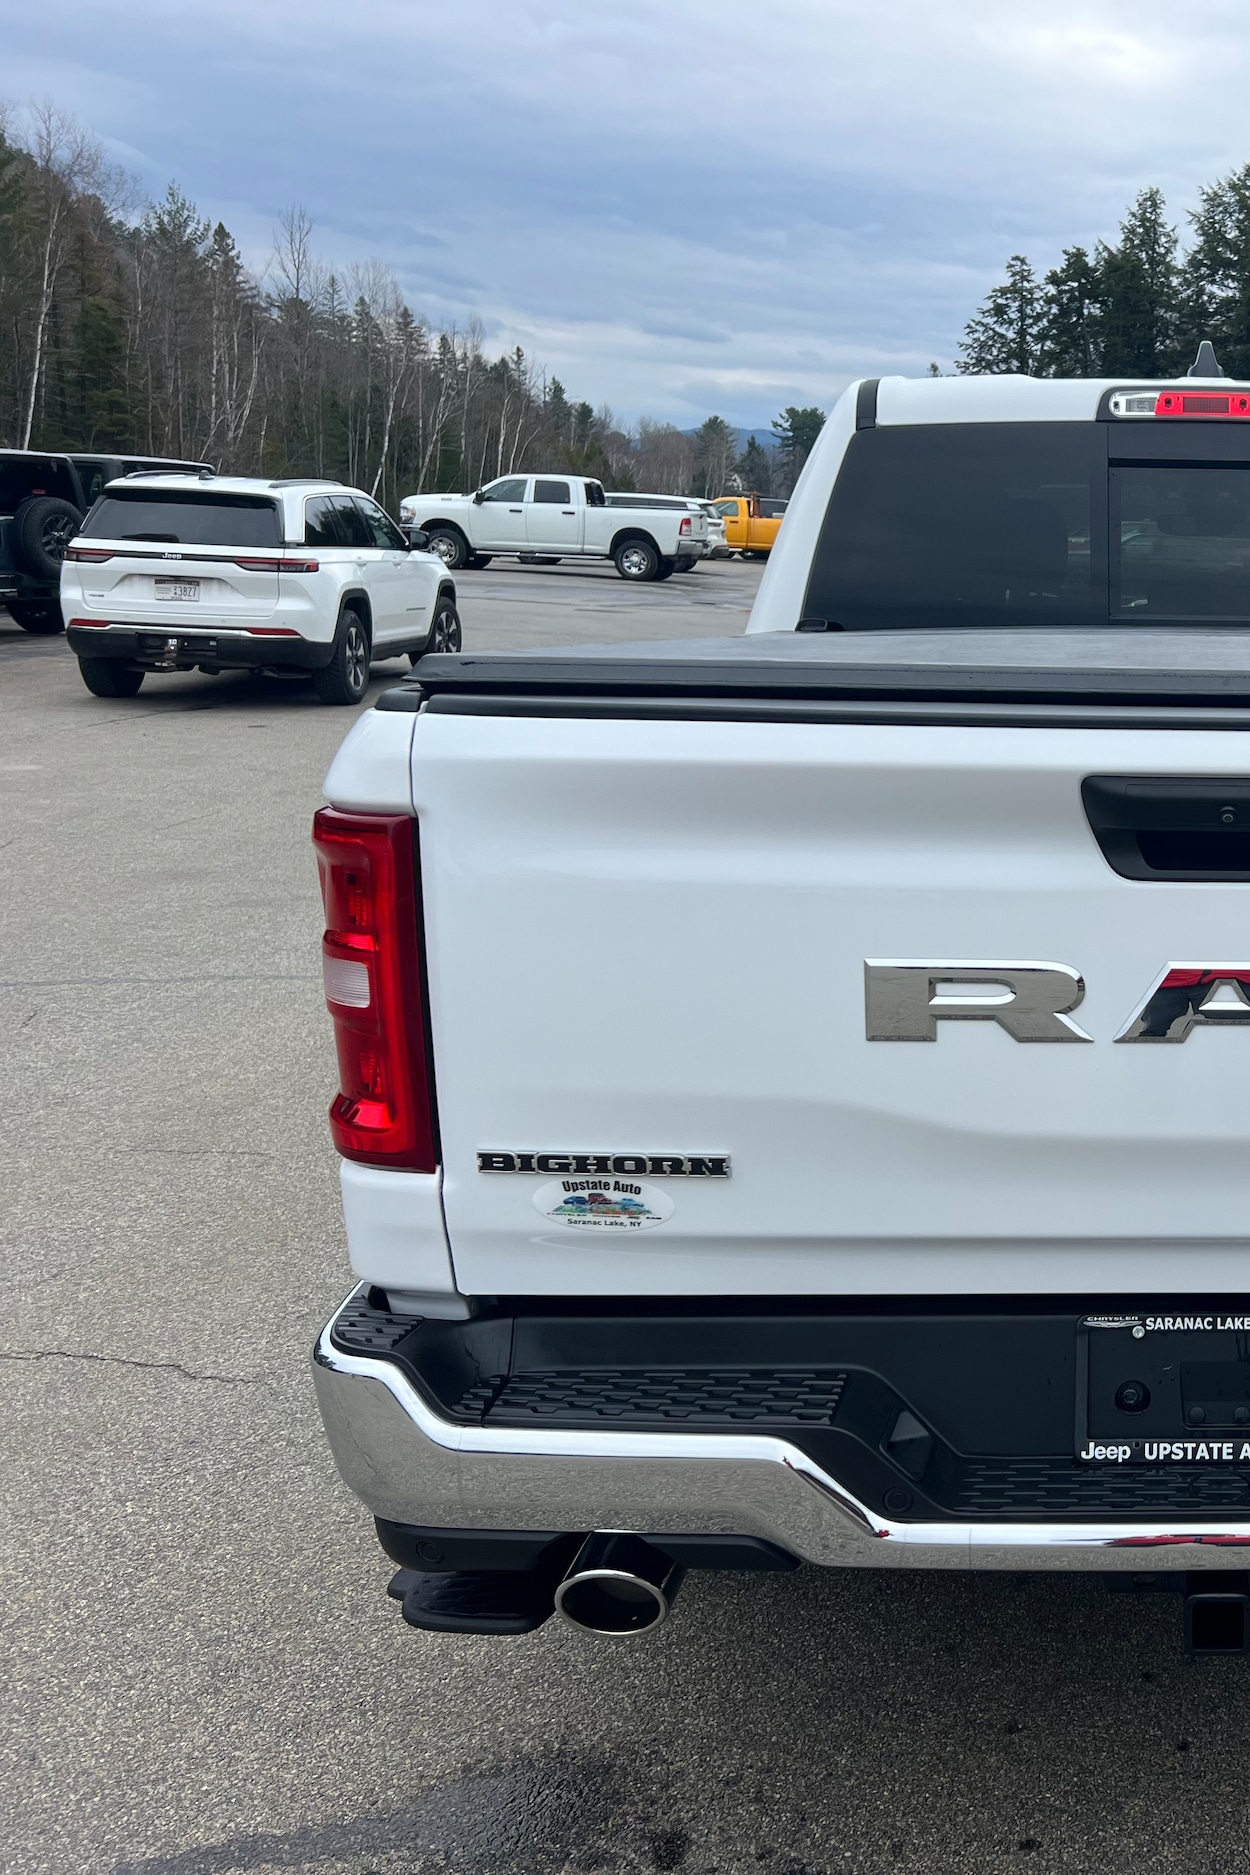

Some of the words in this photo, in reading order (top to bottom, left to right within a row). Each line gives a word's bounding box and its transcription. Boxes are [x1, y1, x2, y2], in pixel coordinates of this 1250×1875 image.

[162, 552, 182, 560] Jeep
[477, 1150, 732, 1179] BIGHORN
[562, 1179, 611, 1193] Upstate
[613, 1180, 642, 1195] Auto
[567, 1218, 602, 1226] Saranac
[604, 1219, 627, 1228] Lake,
[1145, 1317, 1213, 1330] SARANAC
[1081, 1442, 1131, 1462] Jeep
[1144, 1443, 1234, 1461] UPSTATE
